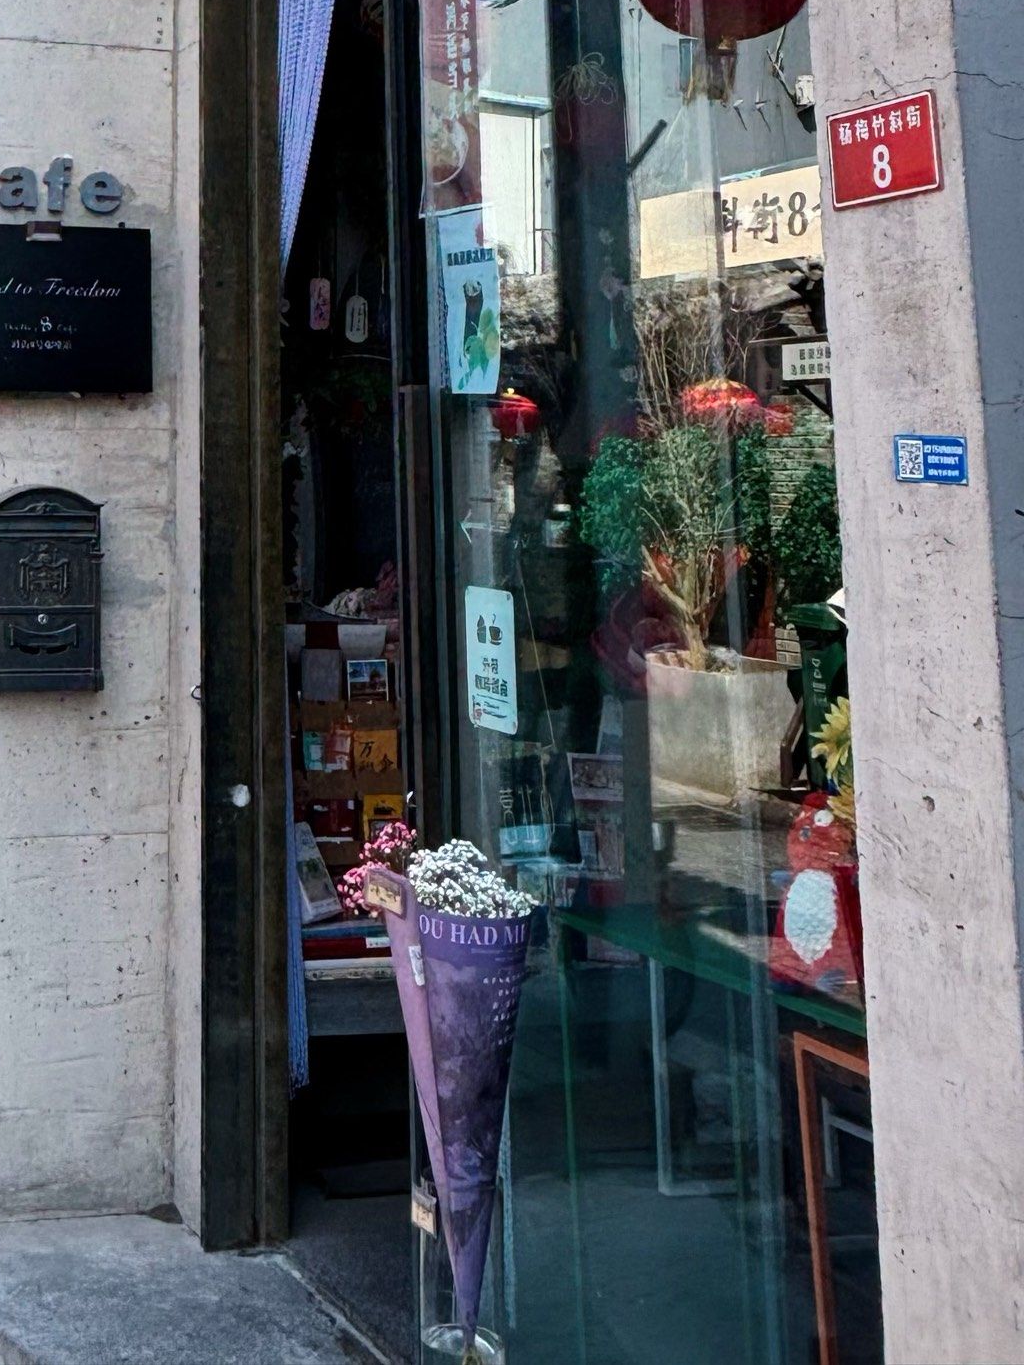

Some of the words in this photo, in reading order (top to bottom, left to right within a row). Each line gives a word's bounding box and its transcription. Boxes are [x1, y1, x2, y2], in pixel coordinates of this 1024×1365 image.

[872, 144, 892, 189] 8
[14, 283, 33, 295] to
[41, 278, 121, 297] Freedom
[451, 923, 498, 946] HAD
